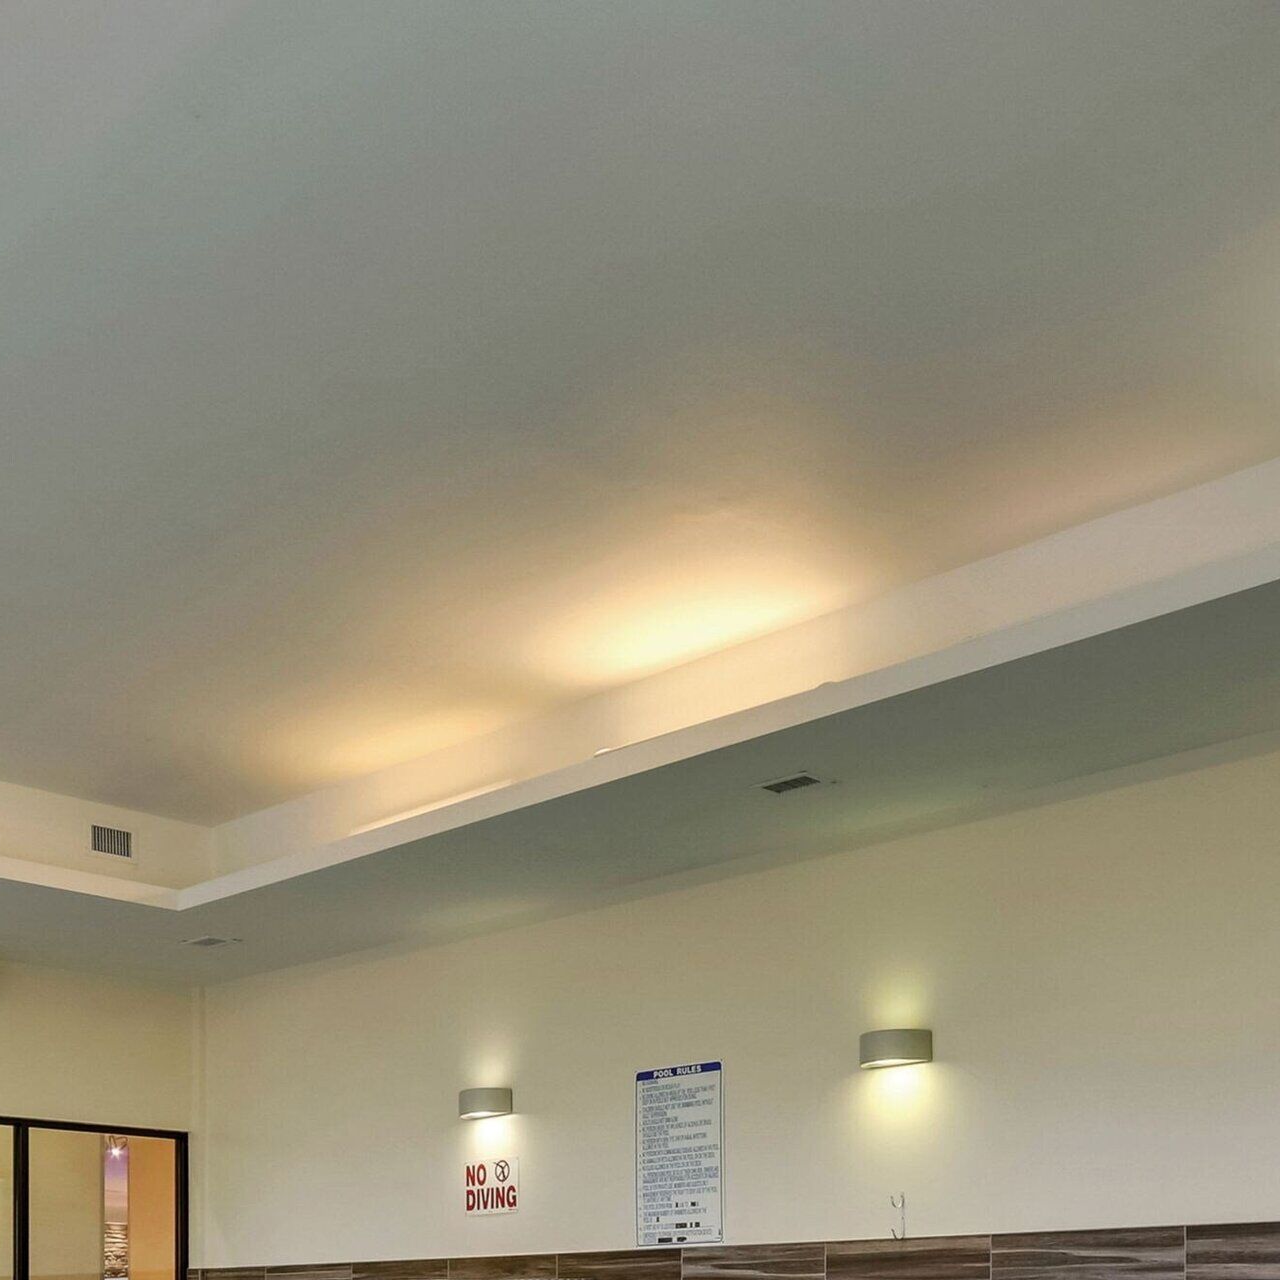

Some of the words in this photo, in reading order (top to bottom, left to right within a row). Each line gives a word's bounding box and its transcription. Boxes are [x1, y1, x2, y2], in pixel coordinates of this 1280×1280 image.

[653, 1070, 674, 1079] POOL
[676, 1065, 702, 1076] RULES
[466, 1164, 487, 1187] NO
[466, 1185, 517, 1211] DIVING
